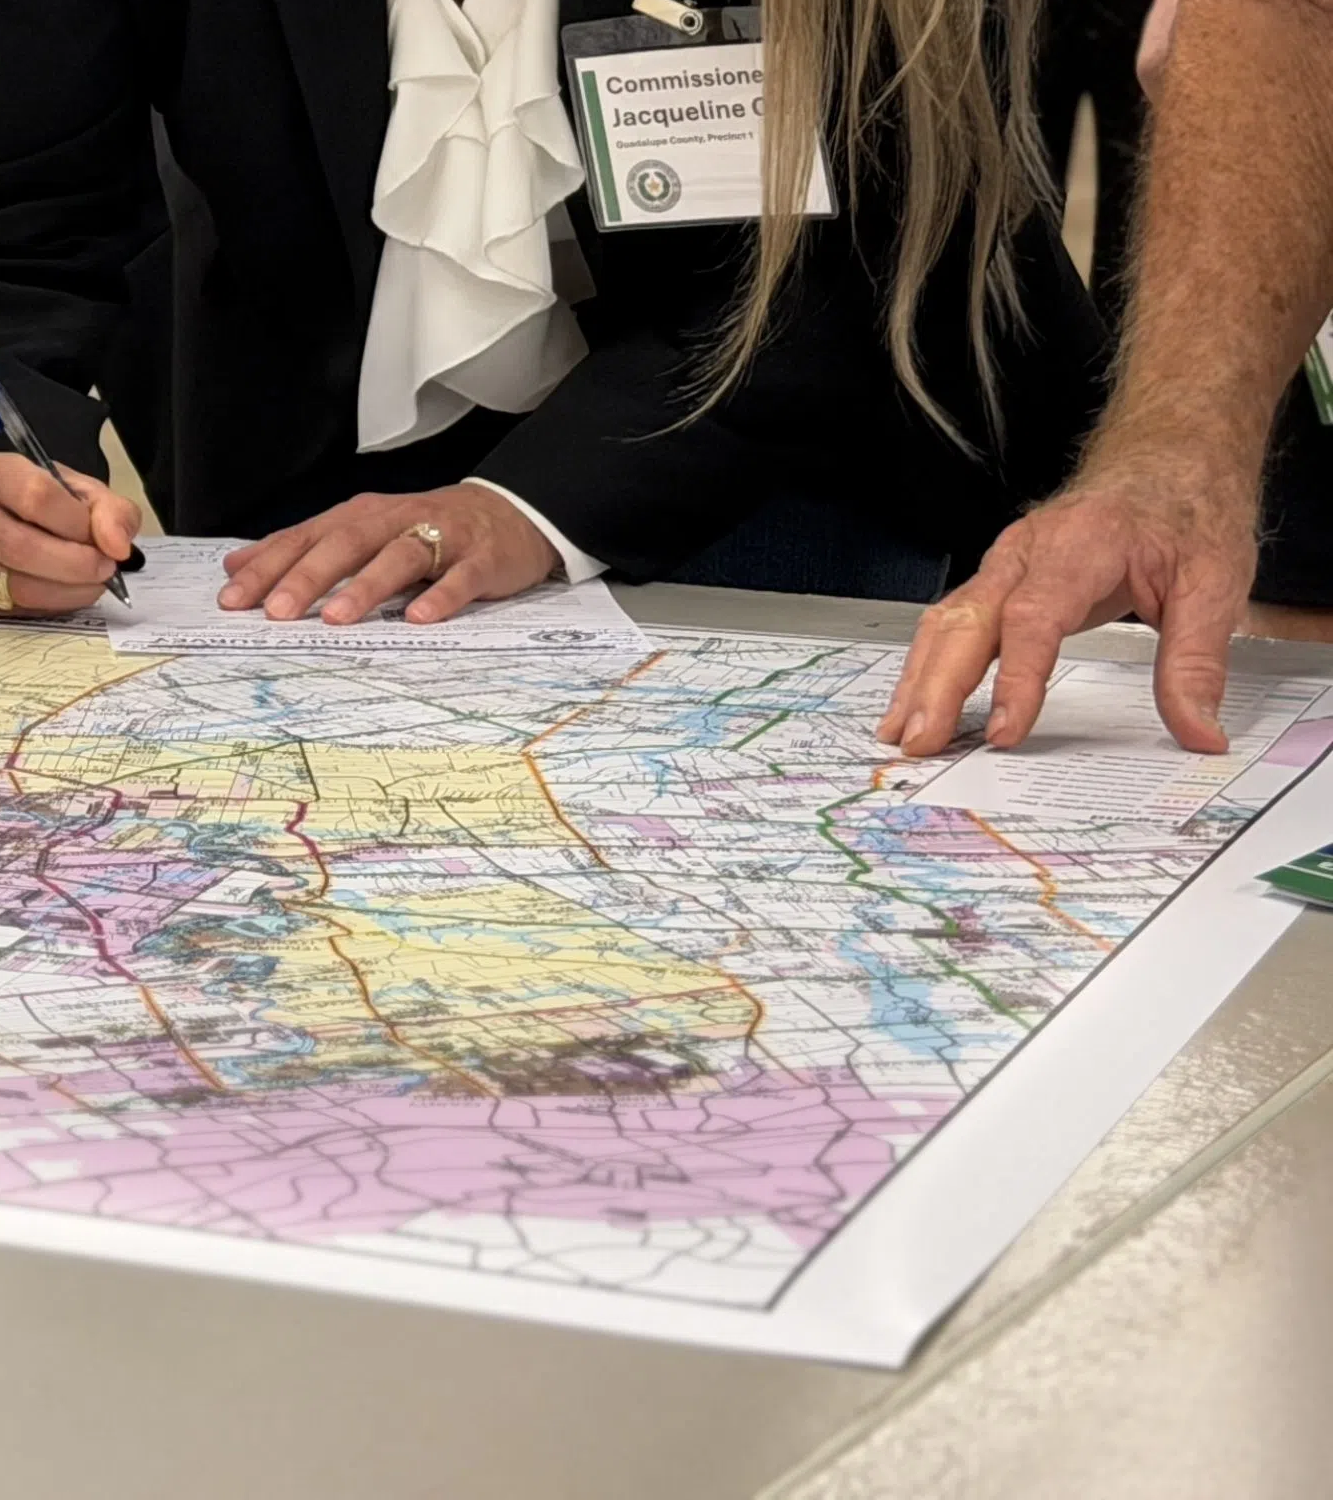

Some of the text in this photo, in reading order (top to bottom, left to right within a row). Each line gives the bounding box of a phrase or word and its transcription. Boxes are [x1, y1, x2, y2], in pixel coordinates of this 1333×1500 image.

[606, 68, 765, 94] Commissione
[613, 100, 746, 128] Jacqueline
[616, 131, 754, 149] Guadalupe County, Precinct 1
